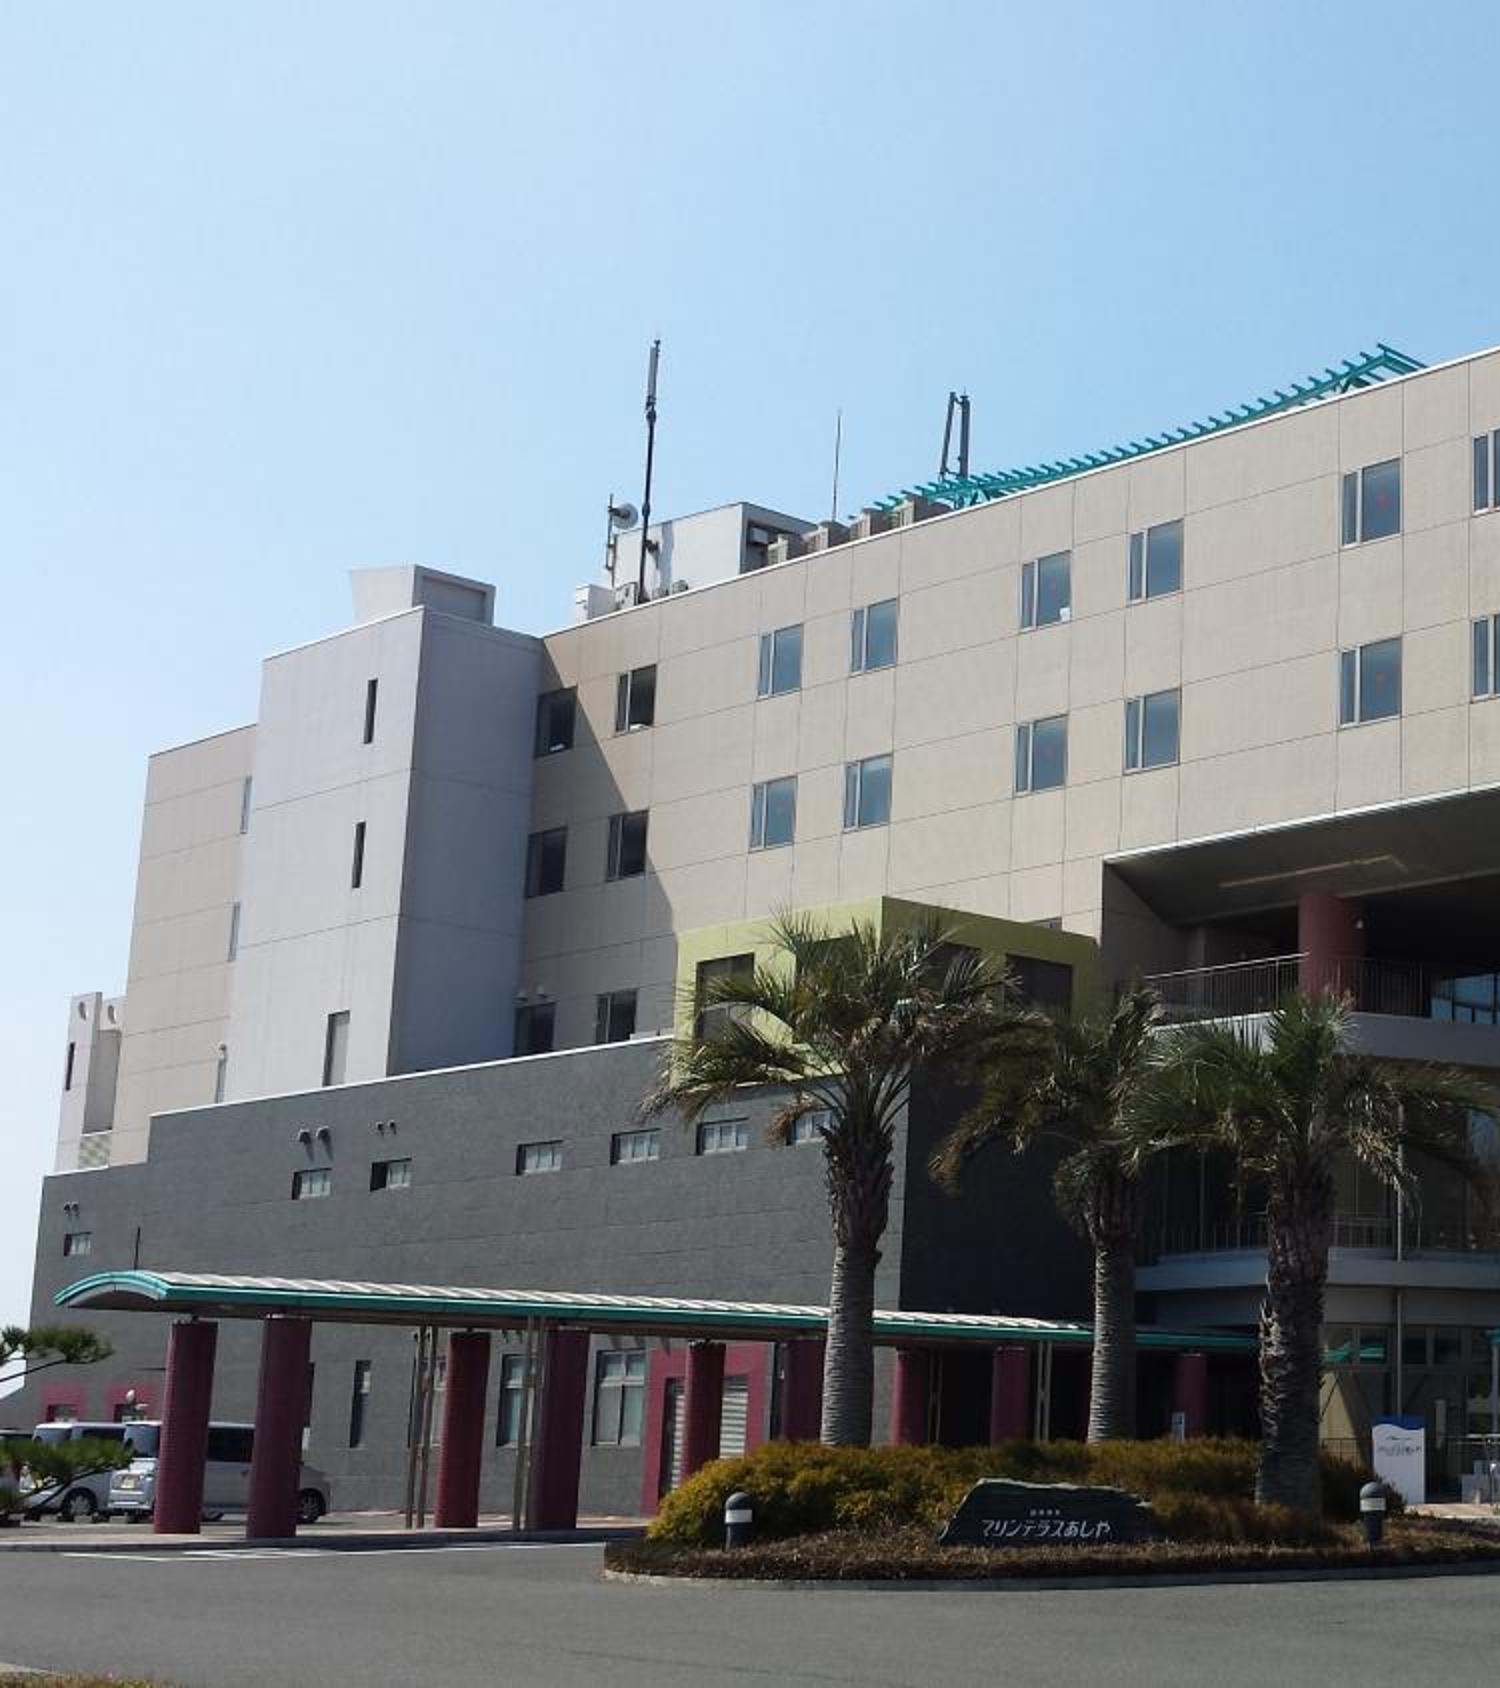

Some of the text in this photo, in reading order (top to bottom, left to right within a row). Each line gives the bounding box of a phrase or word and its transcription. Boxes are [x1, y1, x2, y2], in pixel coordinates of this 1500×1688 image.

[981, 1519, 1112, 1538] マリンテラスあしや
